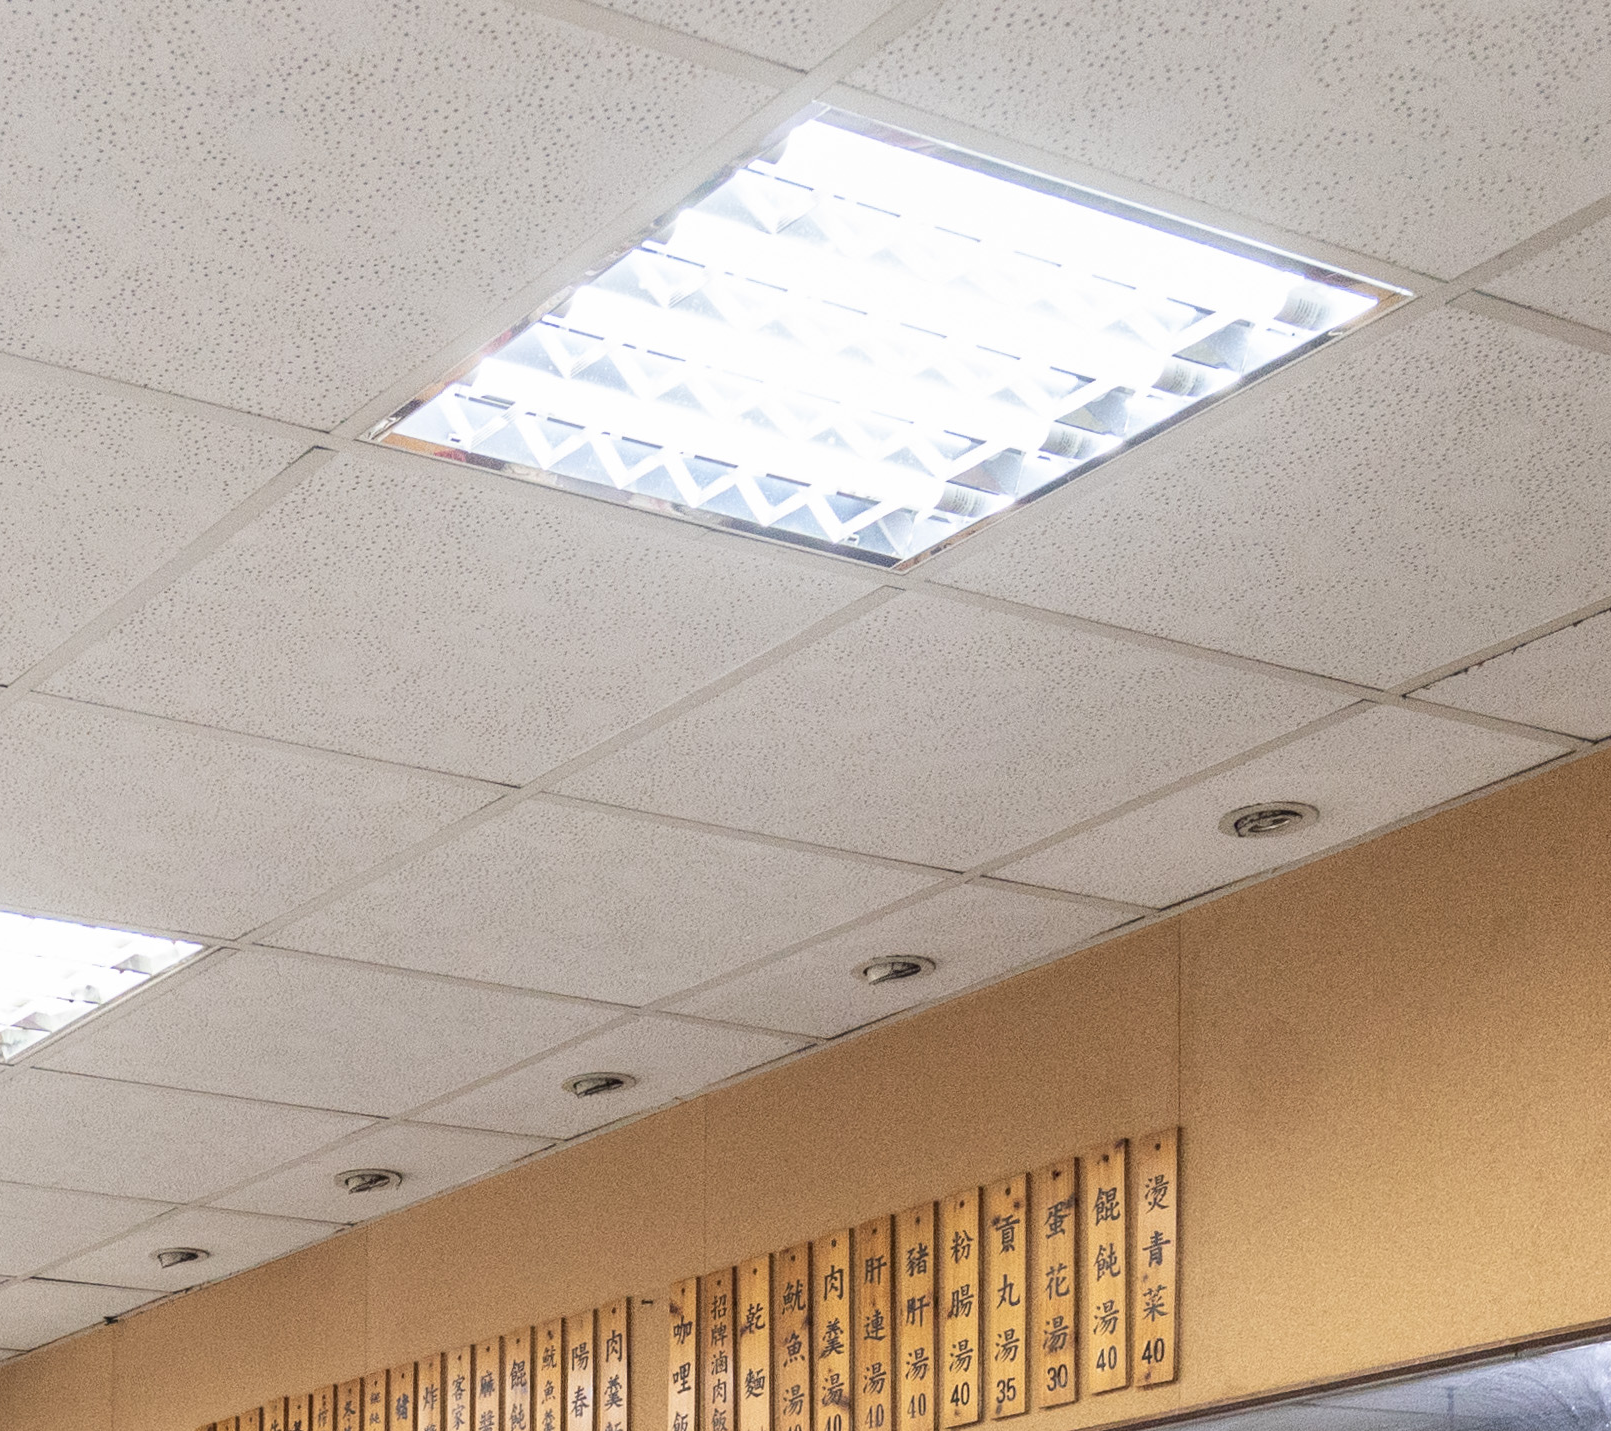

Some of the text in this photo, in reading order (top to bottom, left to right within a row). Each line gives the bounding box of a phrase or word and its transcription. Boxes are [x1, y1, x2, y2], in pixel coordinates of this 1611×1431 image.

[744, 1303, 765, 1399] 乾麵
[782, 1279, 806, 1416] 魷魚湯
[820, 1265, 845, 1406] 肉羹湯
[863, 1255, 887, 1428] 肝連湯 40
[905, 1243, 929, 1419] 豬肝湯 40
[949, 1230, 974, 1406] 粉腸湯 40
[994, 1214, 1020, 1404] 貢丸湯 35
[1043, 1202, 1070, 1391] 蛋花湯 30
[1093, 1188, 1120, 1371] 餛飩湯 40
[1142, 1175, 1170, 1364] 燙青菜 40
